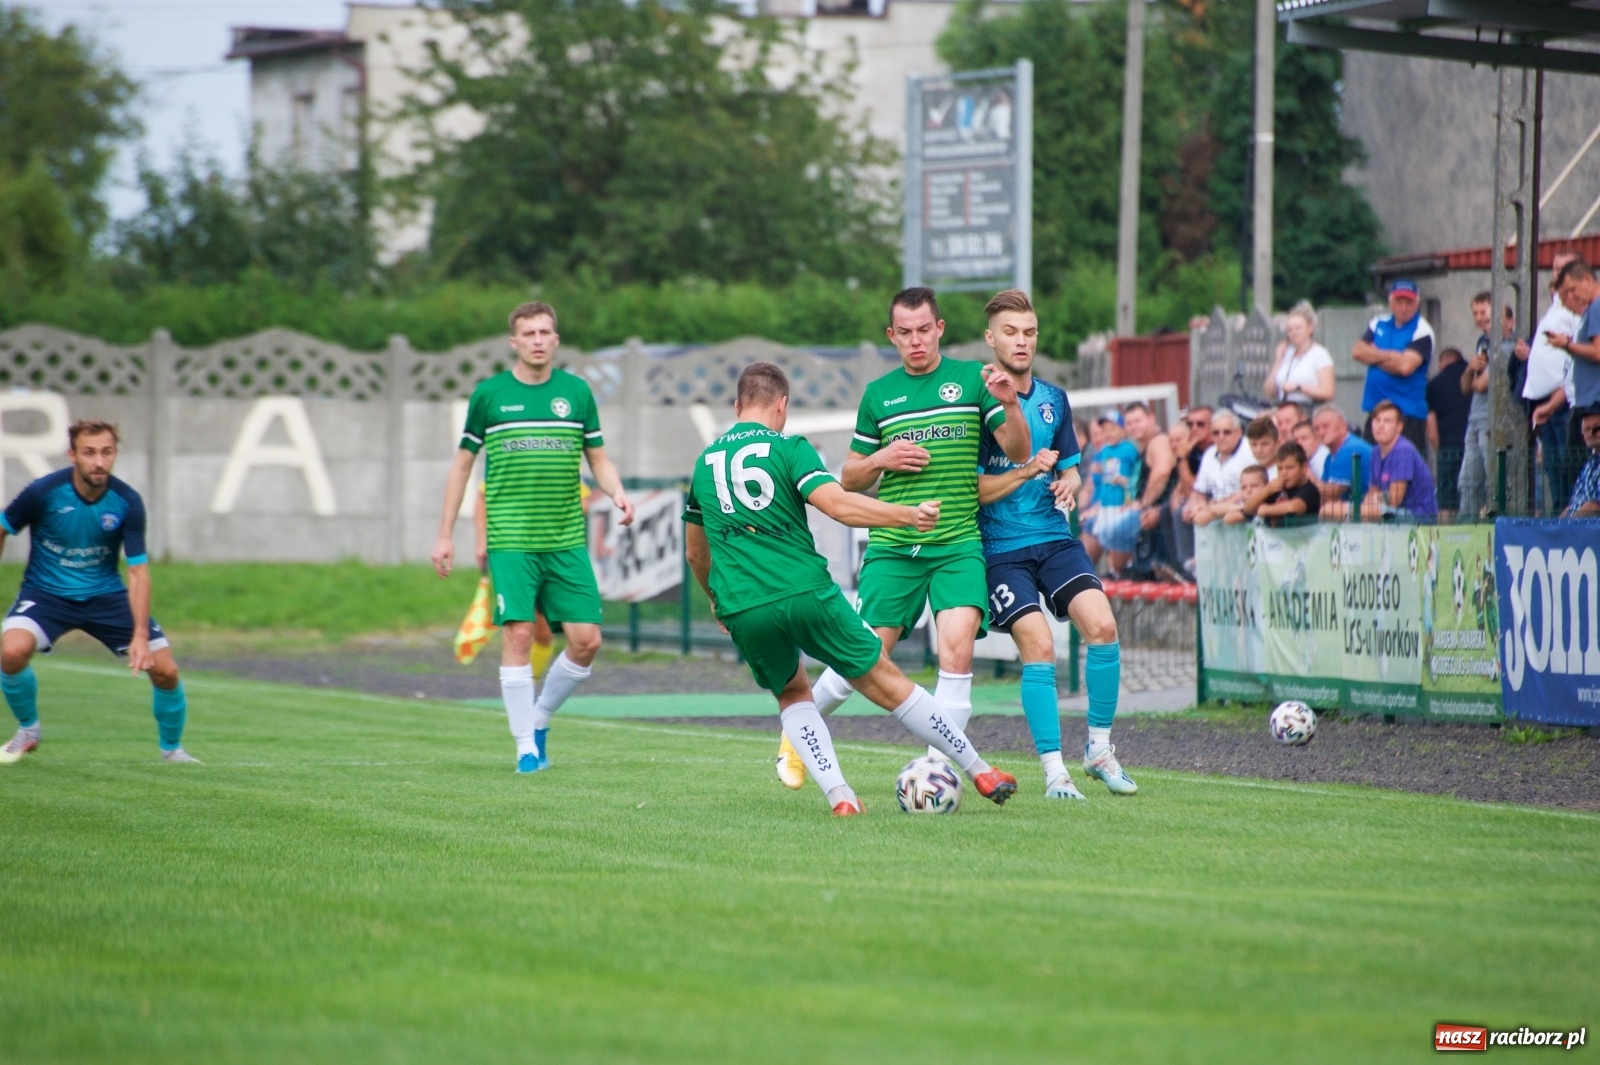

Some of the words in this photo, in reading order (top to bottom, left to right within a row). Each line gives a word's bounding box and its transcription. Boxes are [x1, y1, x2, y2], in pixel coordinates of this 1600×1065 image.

[211, 395, 338, 516] A
[705, 442, 775, 514] 16
[988, 455, 1011, 468] MW
[991, 583, 1015, 614] 13
